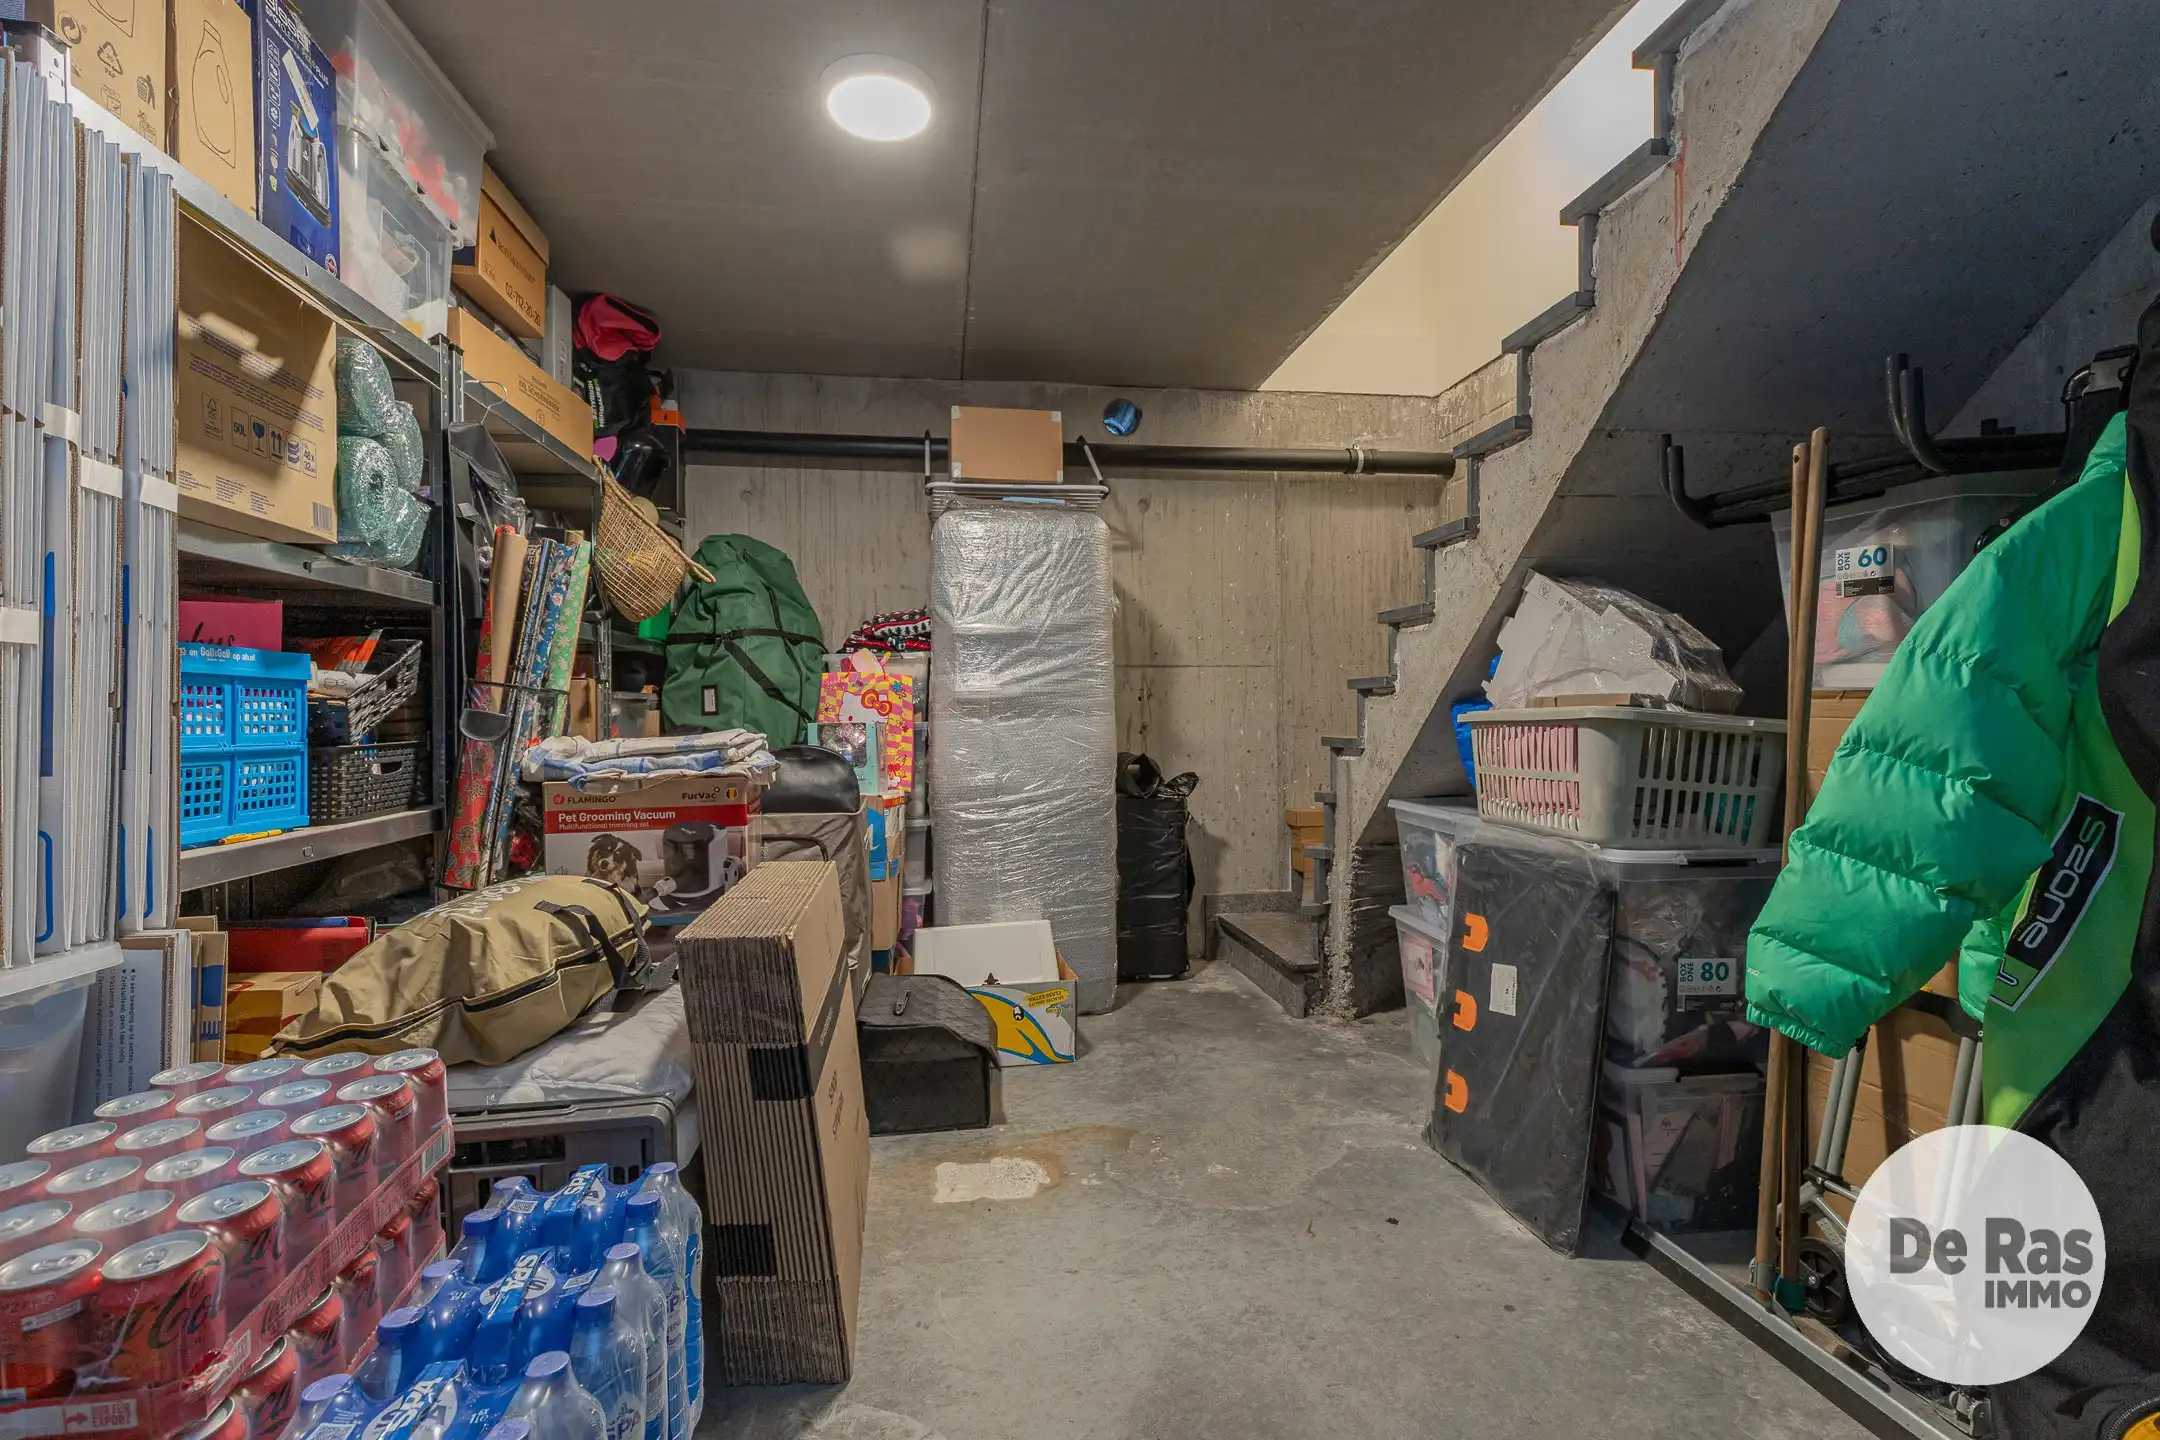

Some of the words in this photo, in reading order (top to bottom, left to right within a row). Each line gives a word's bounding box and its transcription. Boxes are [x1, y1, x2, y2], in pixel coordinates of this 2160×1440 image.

[1843, 551, 1851, 571] ONE
[1857, 546, 1888, 568] 60
[567, 795, 617, 805] FLAMINGO
[682, 792, 717, 801] FurVac
[558, 813, 577, 822] Pet
[579, 812, 631, 824] Grooming
[633, 810, 676, 820] Vacuum
[639, 820, 650, 828] set
[1679, 962, 1687, 982] BOX
[1686, 962, 1695, 982] ONE
[1700, 961, 1730, 982] 80
[563, 1169, 595, 1196] SPA
[500, 1254, 539, 1292] SPA
[388, 1377, 443, 1432] SPA
